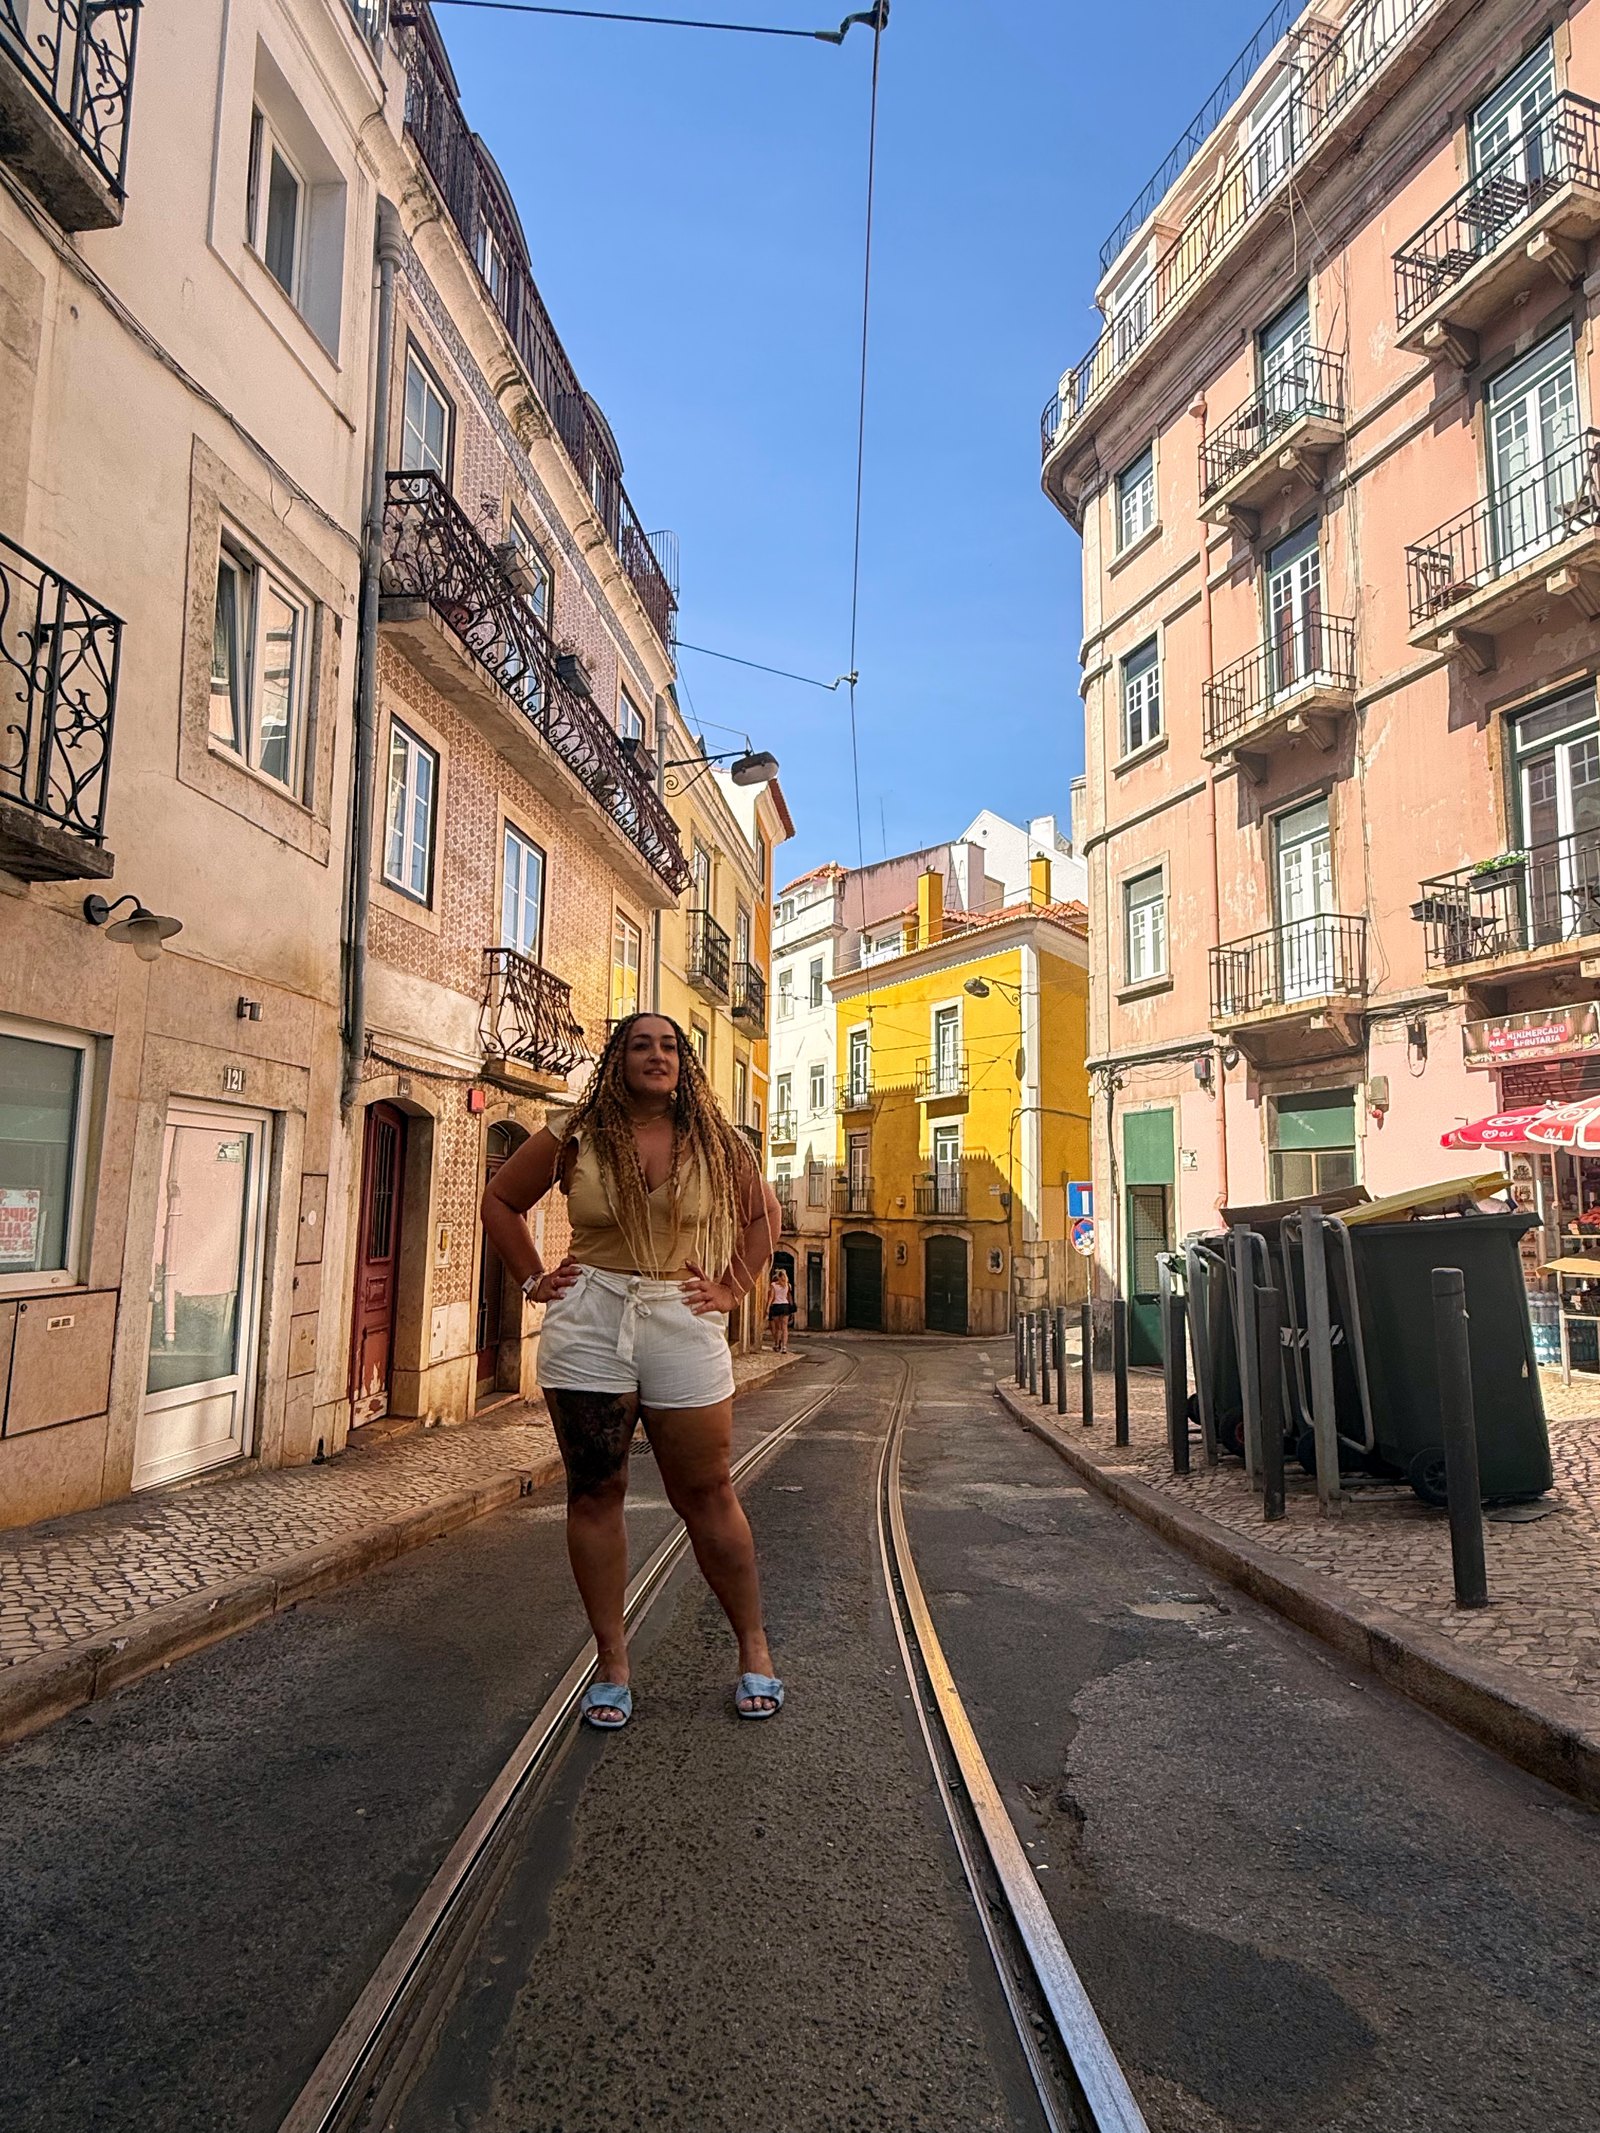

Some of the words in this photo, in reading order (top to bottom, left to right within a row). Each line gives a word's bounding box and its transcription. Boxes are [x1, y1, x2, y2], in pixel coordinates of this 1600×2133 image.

[1507, 1025, 1565, 1040] MINIMERCADO
[226, 1068, 243, 1091] 121
[1499, 1129, 1514, 1137] OLÁ
[1544, 1127, 1564, 1140] OLÁ
